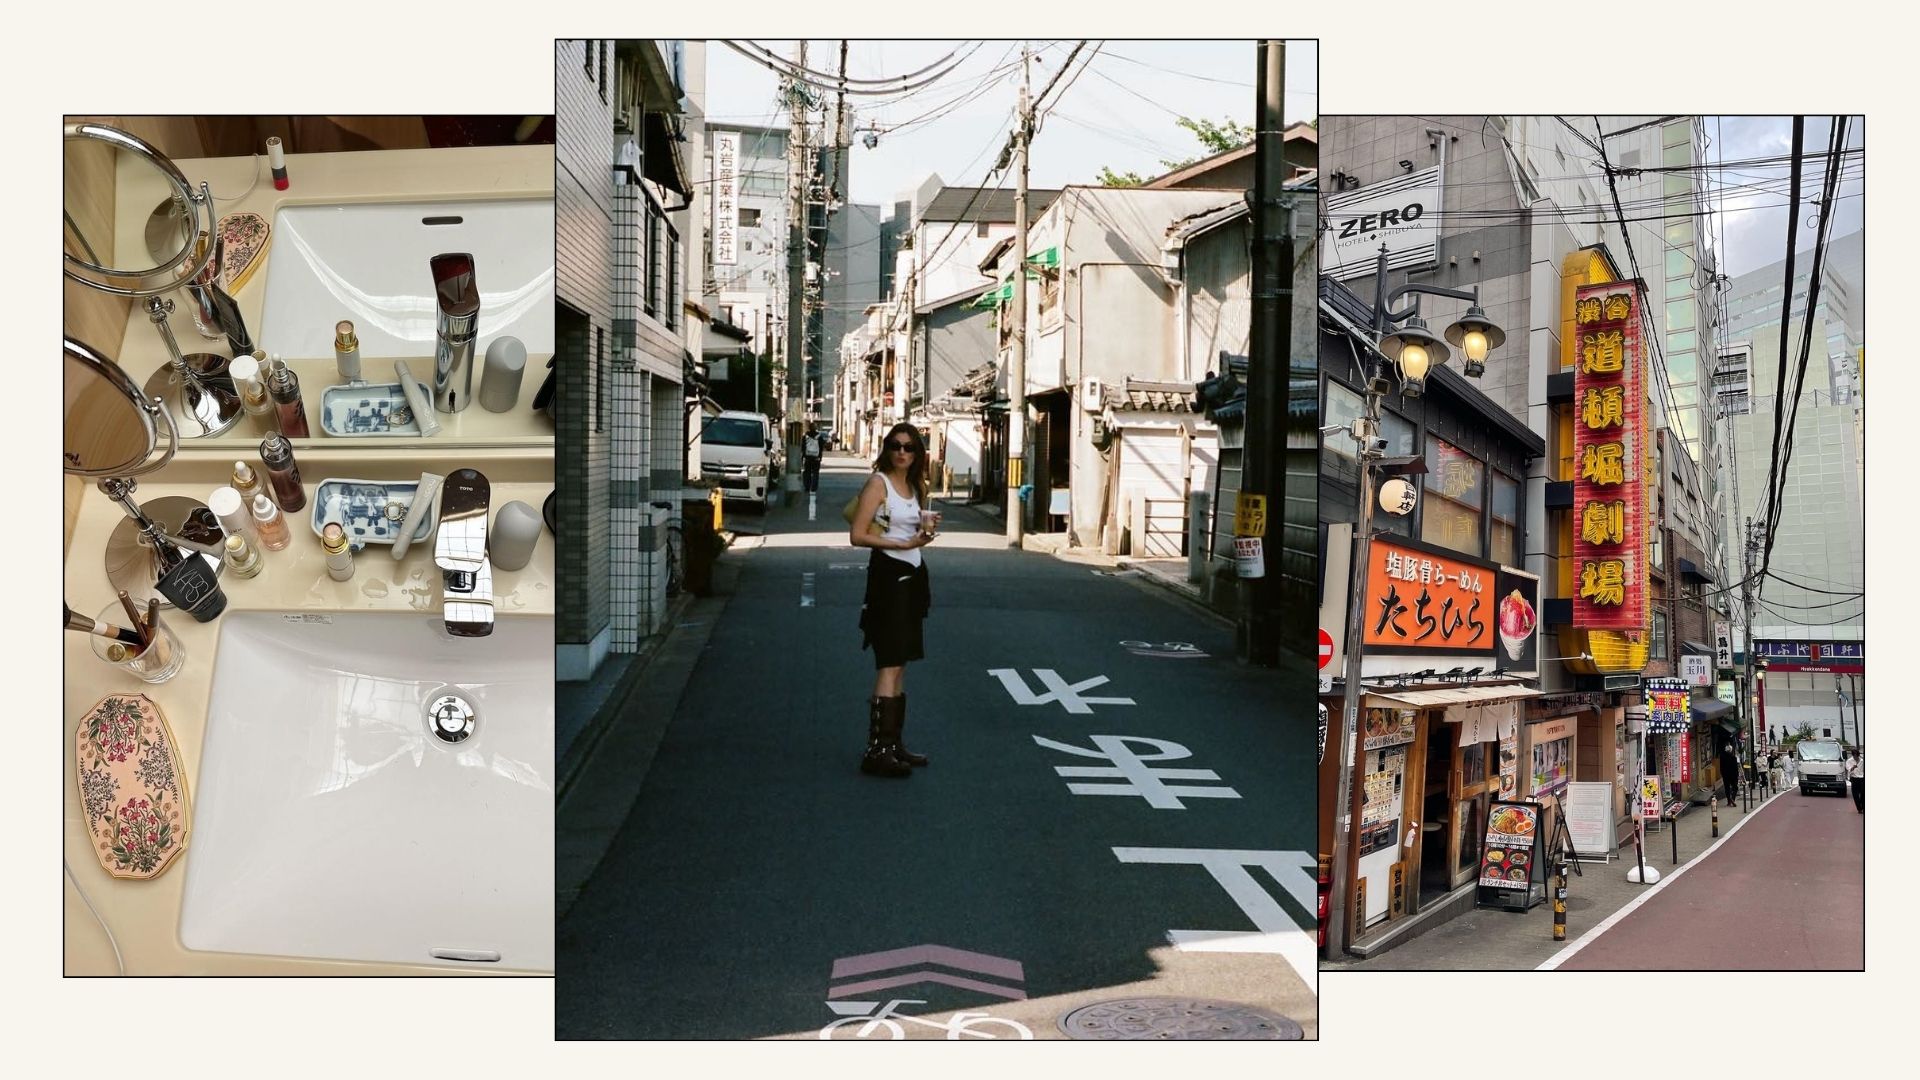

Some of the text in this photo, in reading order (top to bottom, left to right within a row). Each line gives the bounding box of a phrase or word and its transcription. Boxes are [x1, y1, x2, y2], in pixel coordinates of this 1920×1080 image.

[719, 138, 734, 260] 丸岩産業株式会社
[1337, 223, 1423, 248] HOTEL SHIBUYA
[1339, 203, 1423, 240] ZERO
[1580, 330, 1626, 606] 道頓堀劇場
[173, 560, 209, 602] NARS
[1386, 551, 1482, 592] 塩豚骨らーめん
[1374, 584, 1484, 643] たちひら
